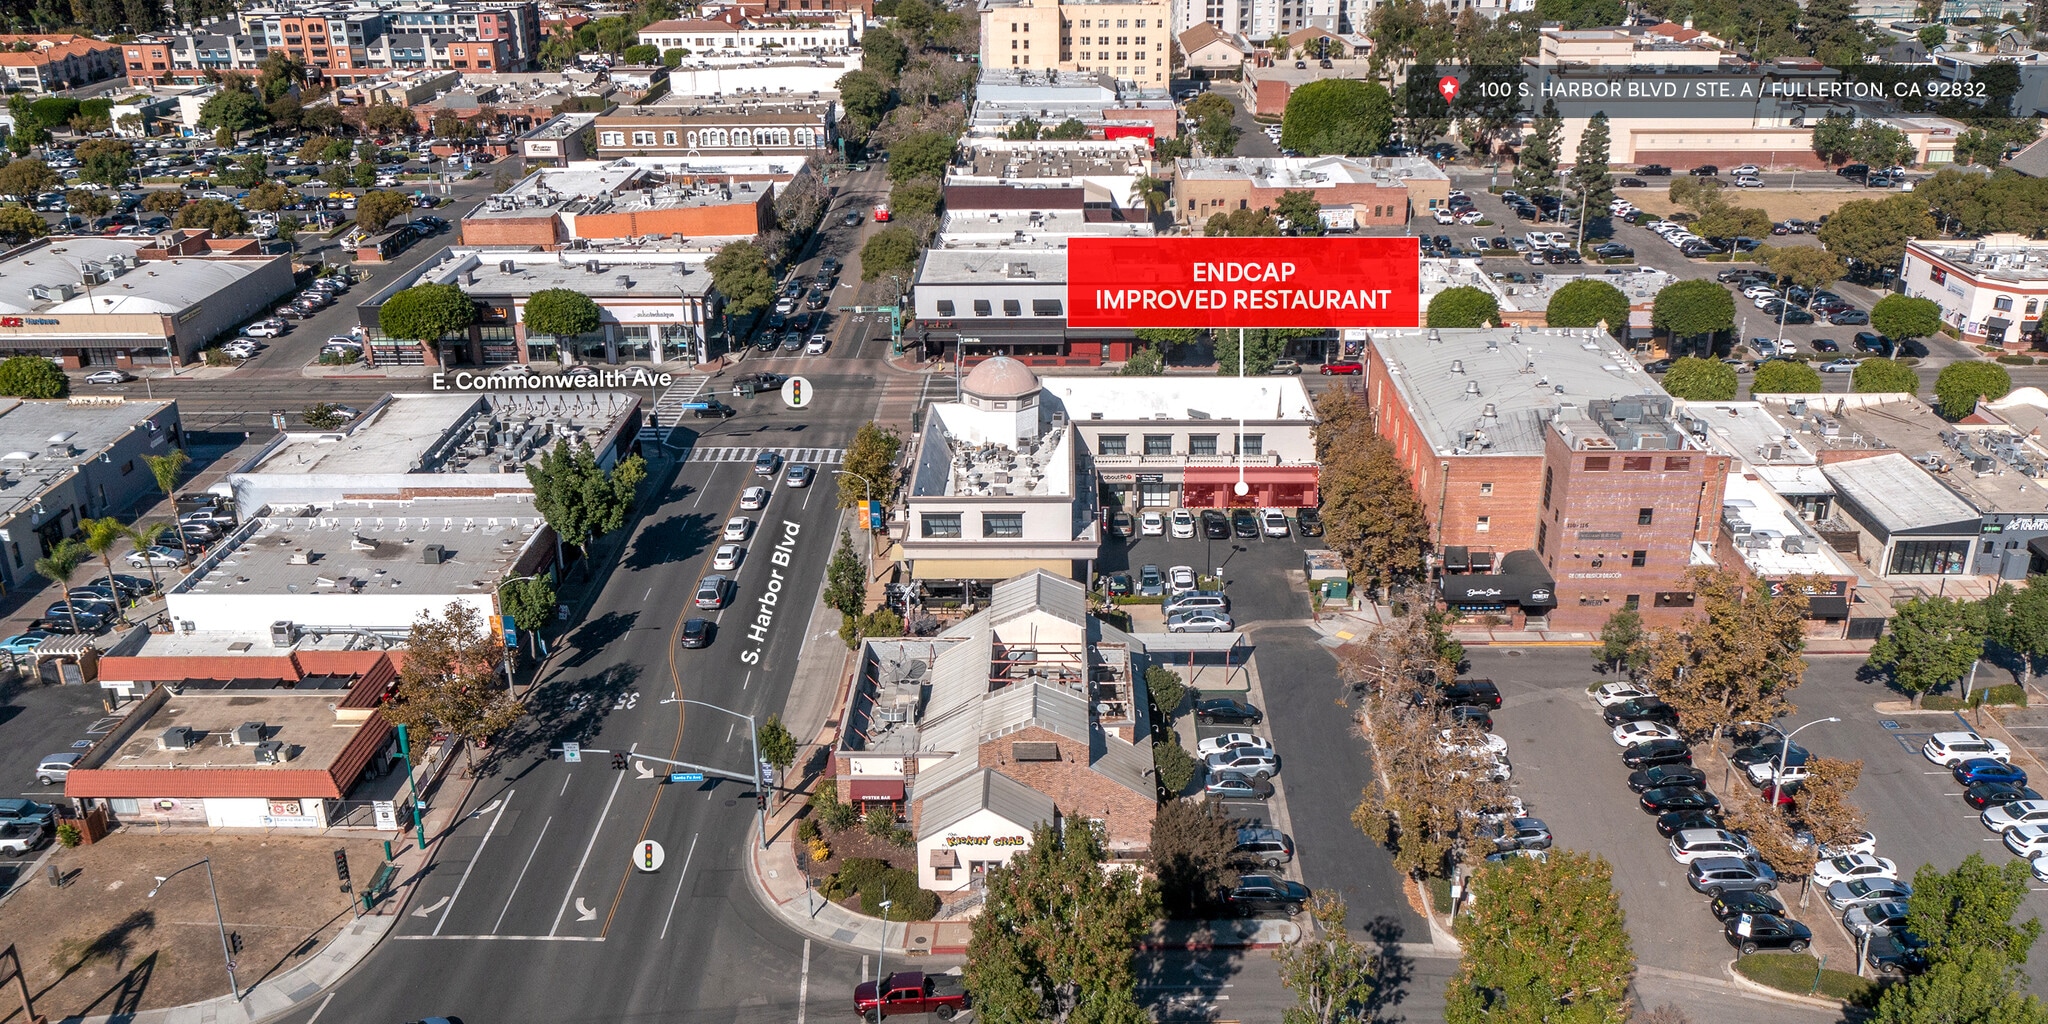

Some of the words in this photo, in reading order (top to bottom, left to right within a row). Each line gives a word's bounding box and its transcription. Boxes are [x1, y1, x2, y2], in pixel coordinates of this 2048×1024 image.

[851, 315, 866, 323] 25
[877, 315, 891, 323] 25
[613, 692, 640, 710] 35
[946, 835, 991, 847] KICKIN'
[993, 835, 1025, 847] CRAB
